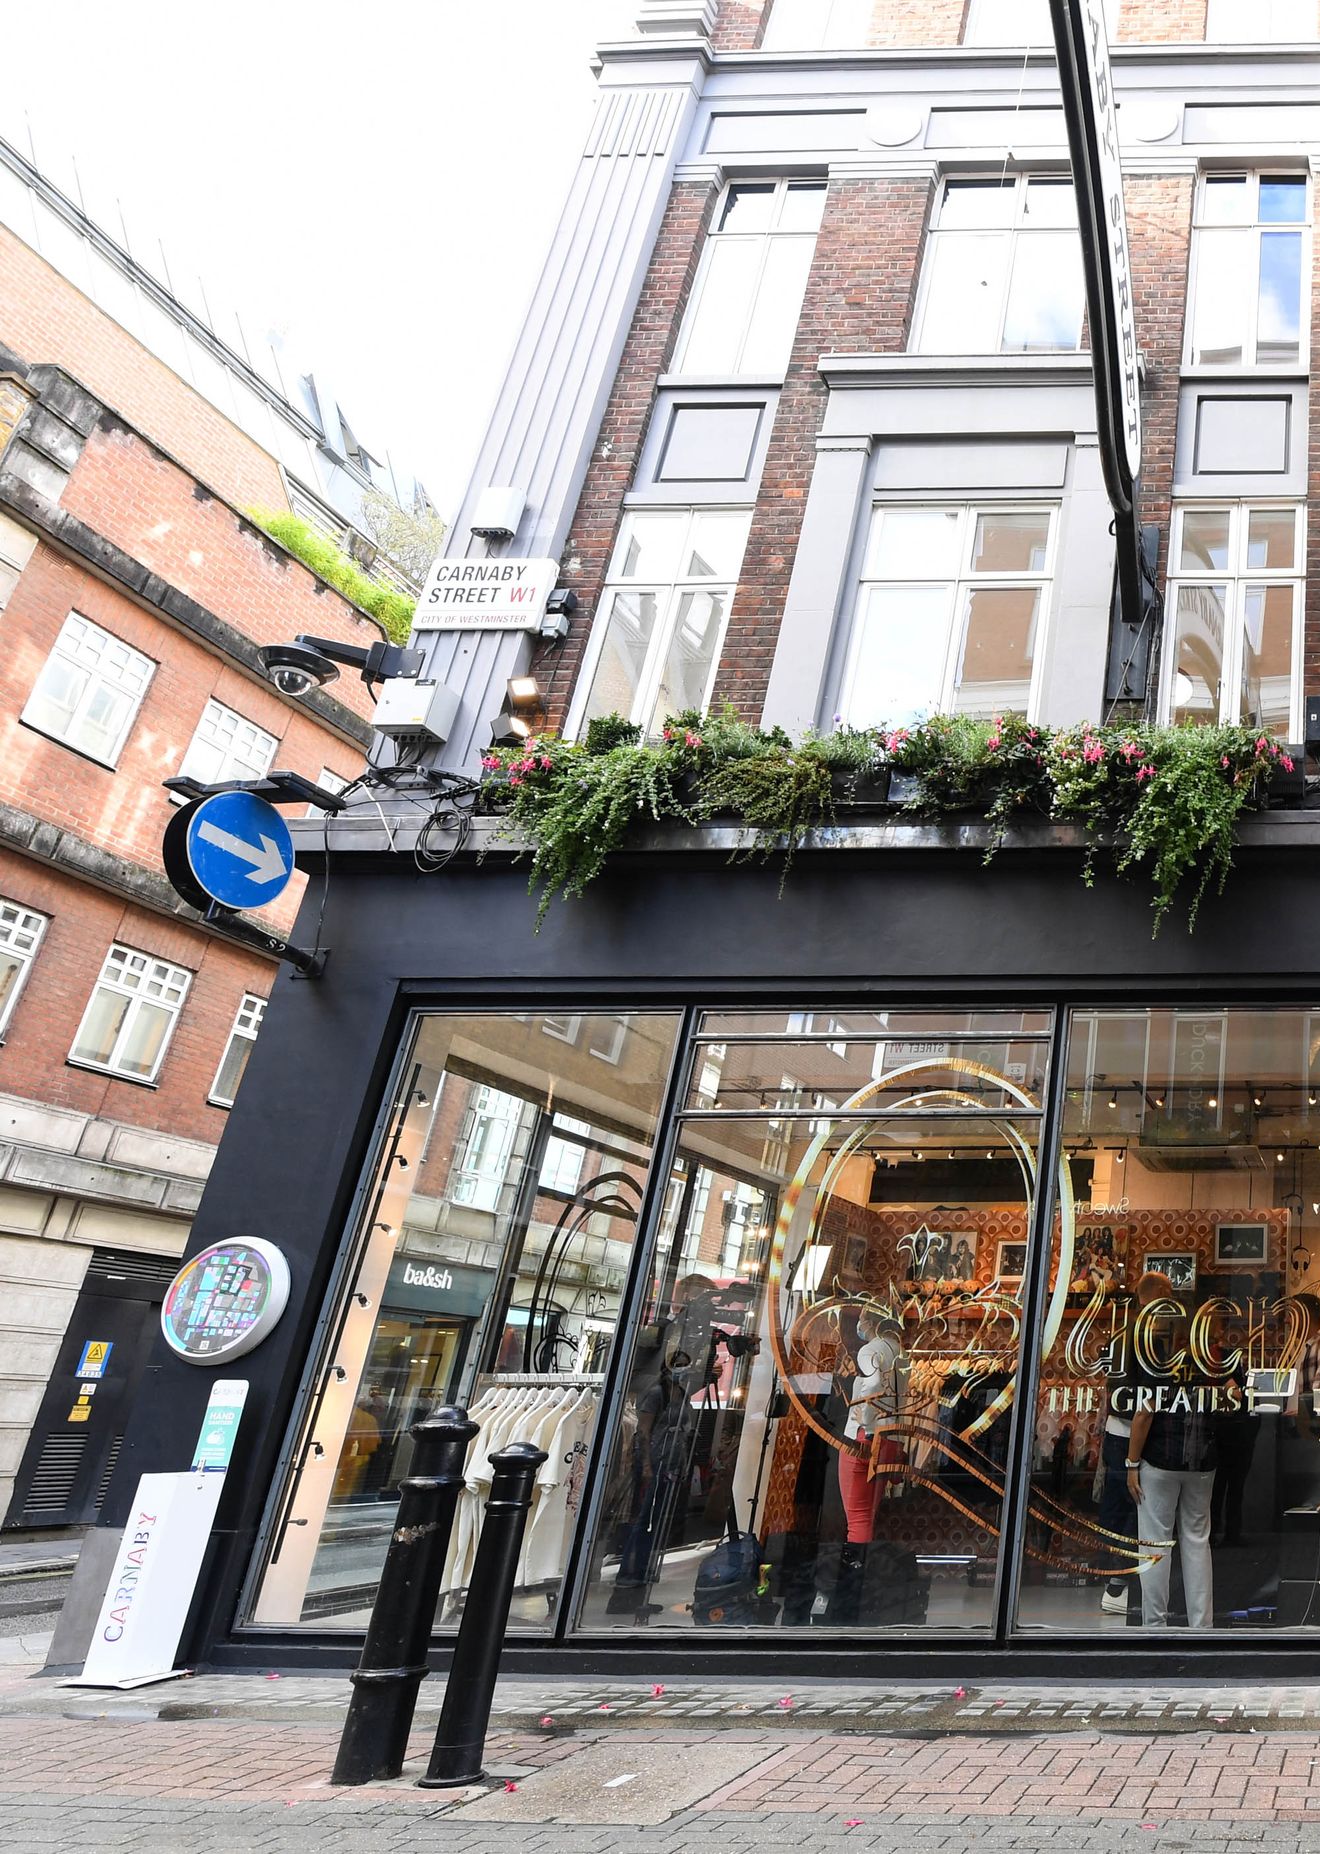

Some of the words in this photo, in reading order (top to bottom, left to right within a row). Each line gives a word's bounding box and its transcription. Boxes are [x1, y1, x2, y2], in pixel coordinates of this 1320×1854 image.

[1086, 0, 1116, 162] ABY
[1110, 193, 1138, 446] STREET
[437, 566, 527, 582] CARNABY
[429, 587, 501, 603] STREET
[510, 587, 536, 602] W1
[421, 615, 442, 624] CITY
[445, 615, 456, 623] OF
[460, 615, 527, 624] WESTMINSTER
[403, 1262, 453, 1290] ba&sh
[1045, 1386, 1104, 1413] THE
[1111, 1386, 1260, 1413] GREATEST
[104, 1512, 157, 1642] CARNABY
